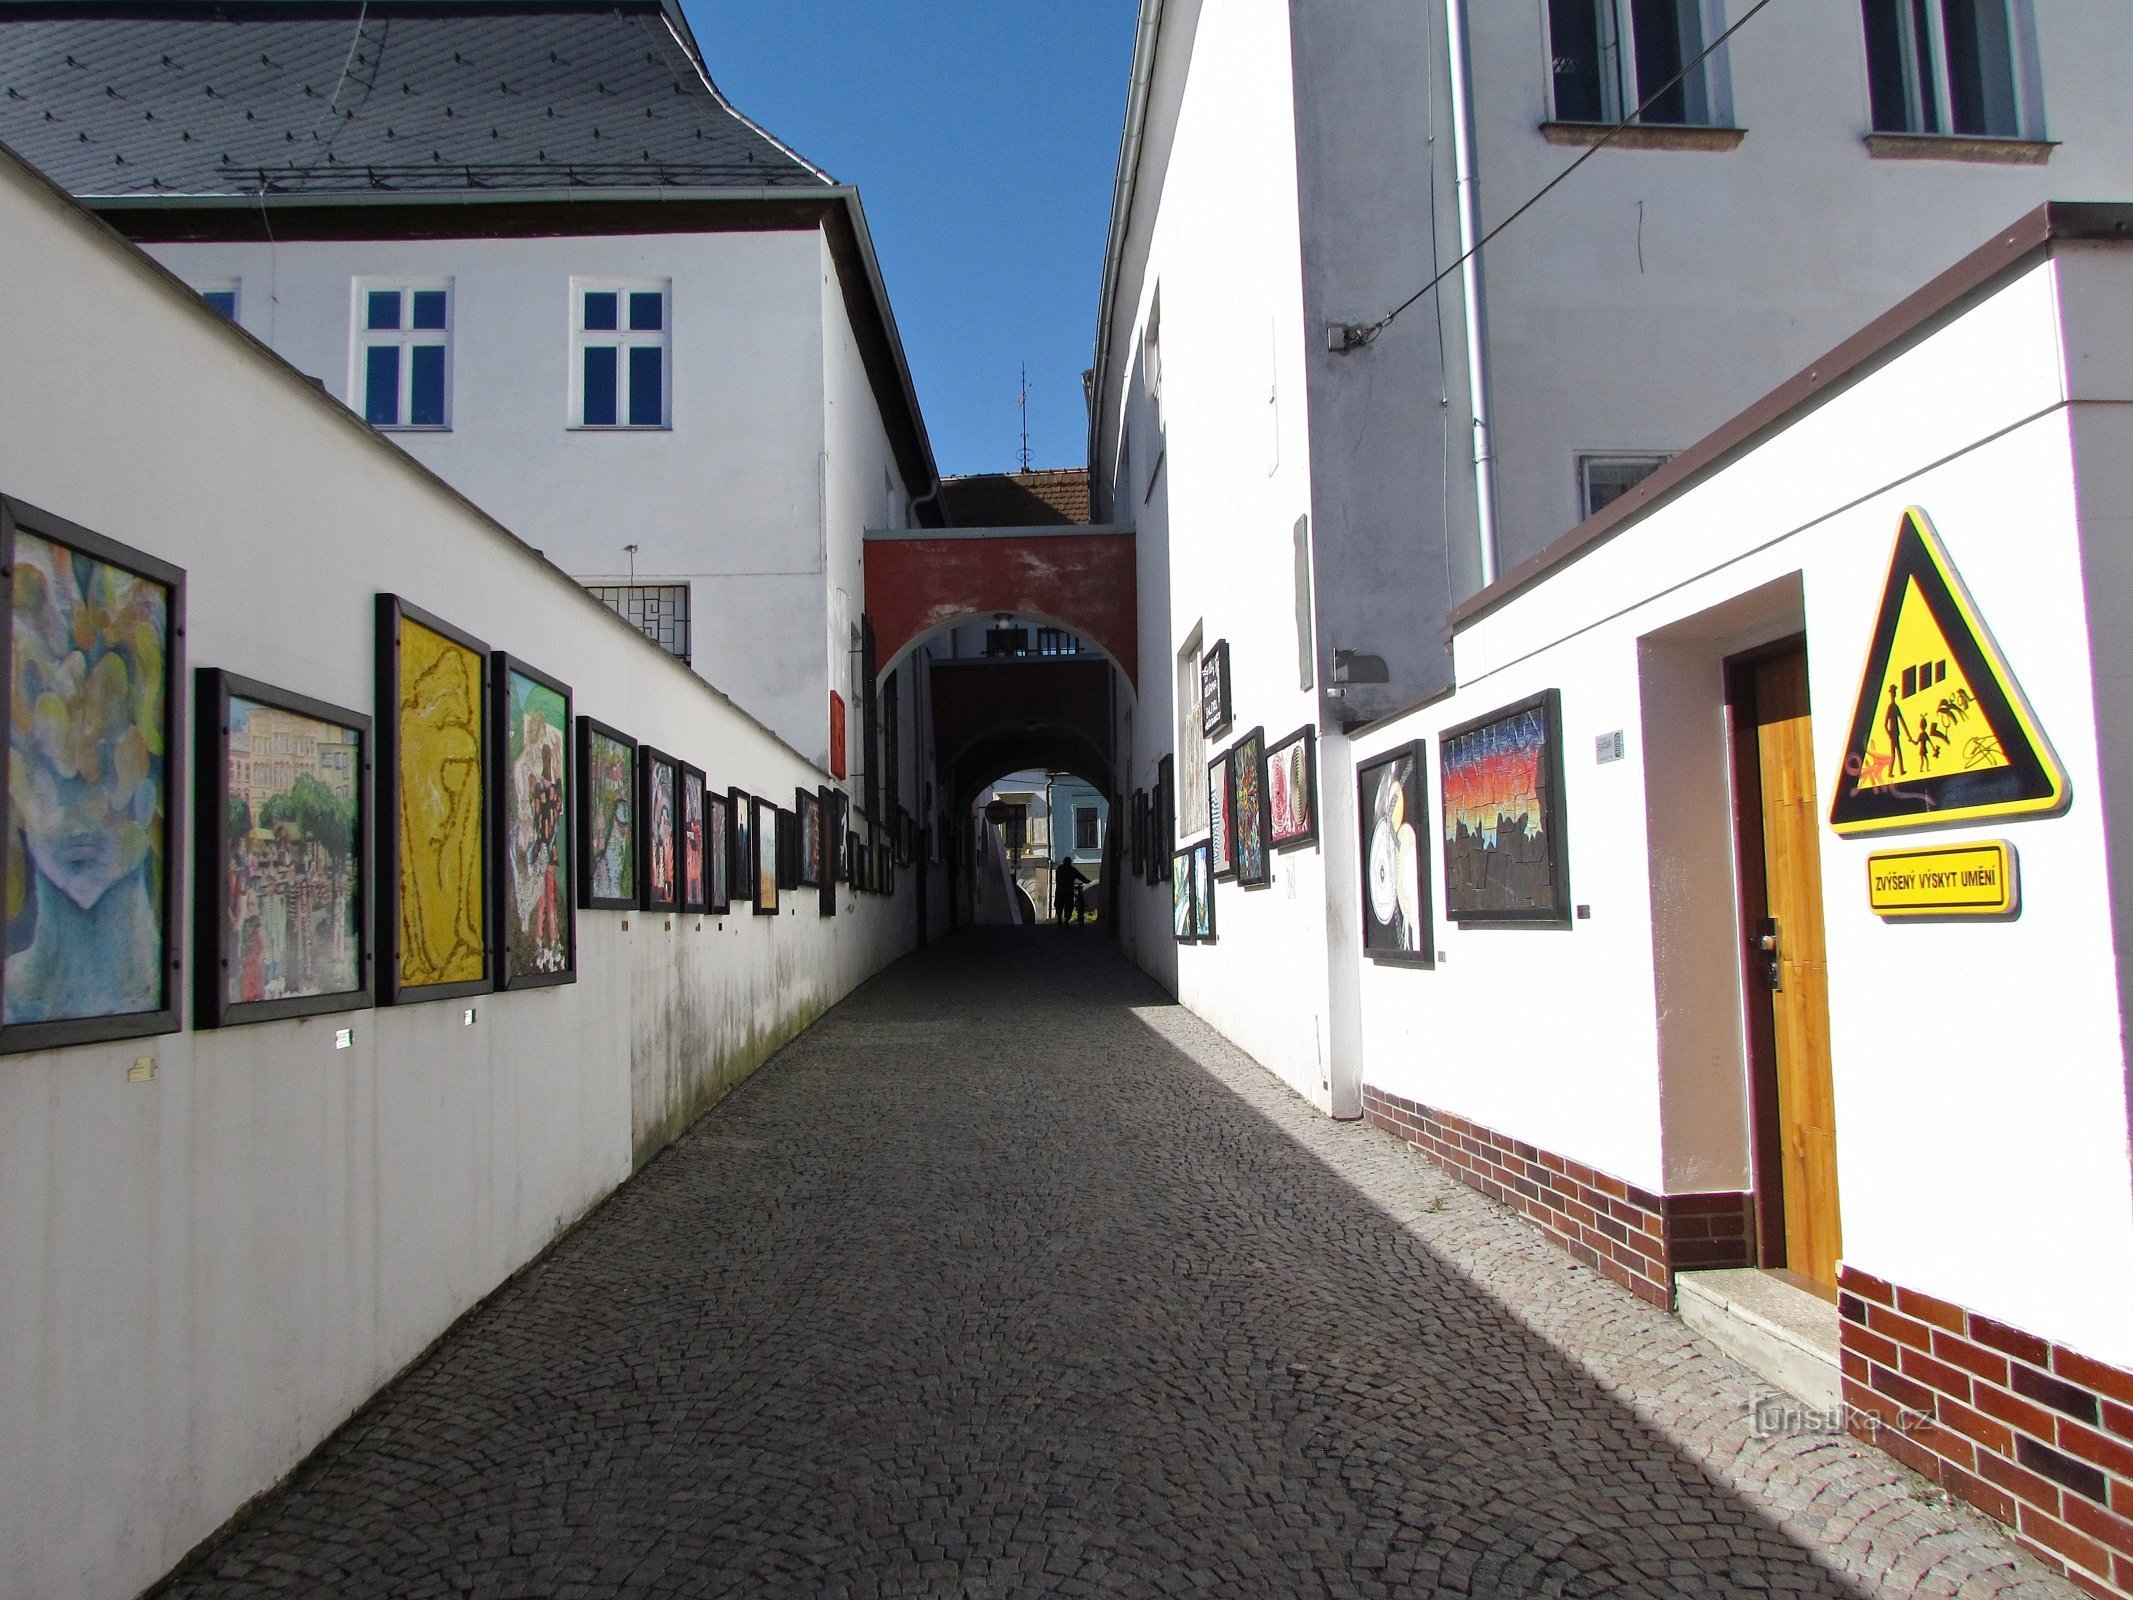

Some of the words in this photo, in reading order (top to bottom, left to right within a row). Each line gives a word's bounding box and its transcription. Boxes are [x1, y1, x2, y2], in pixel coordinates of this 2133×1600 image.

[1875, 870, 1915, 891] ZVÝŠENÝ
[1919, 869, 1957, 889] VÝSKYT
[1961, 865, 1996, 887] UMĚNÍ
